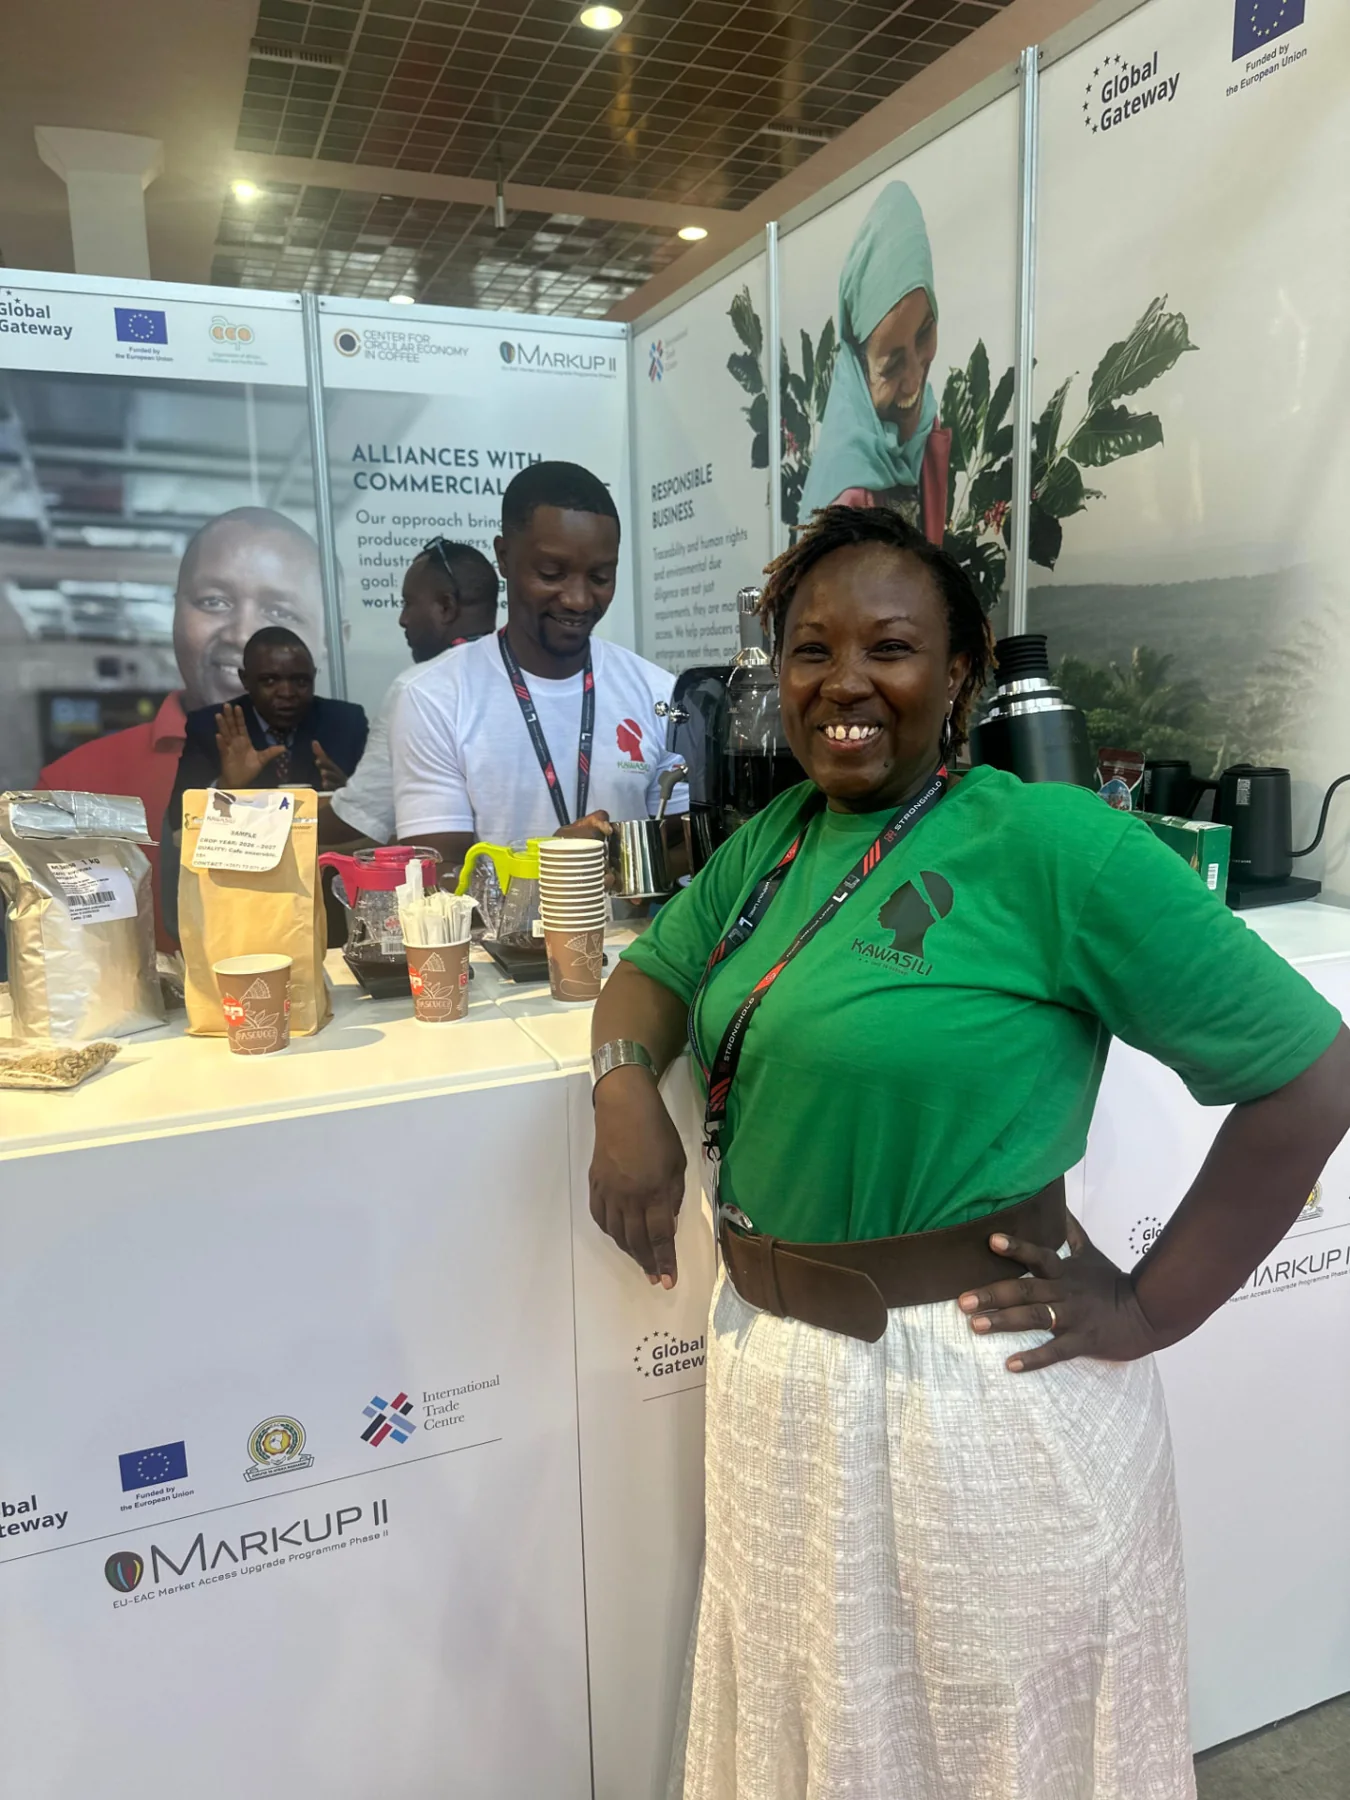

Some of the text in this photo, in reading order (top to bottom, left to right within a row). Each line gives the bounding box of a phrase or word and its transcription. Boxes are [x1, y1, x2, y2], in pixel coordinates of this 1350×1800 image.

[1245, 42, 1290, 72] Funded by
[1101, 51, 1158, 104] Global
[1225, 47, 1308, 97] the European Union
[1100, 73, 1180, 132] Gateway
[0, 302, 51, 319] Global
[0, 319, 73, 341] Gateway
[363, 329, 431, 343] CENTER FOR
[126, 353, 155, 362] European
[129, 346, 152, 354] Funded
[363, 340, 469, 356] CIRCULAR ECONOMY
[364, 350, 420, 363] IN COFFEE
[351, 444, 543, 470] ALLIANCES WITH
[353, 471, 504, 496] COMMERCIAL
[651, 463, 713, 503] RESPONSIBLE
[355, 509, 386, 524] Our
[391, 512, 463, 530] approach
[652, 499, 695, 530] BUSINESS
[687, 536, 699, 553] and
[700, 535, 724, 549] human
[725, 526, 748, 547] rights
[359, 551, 414, 568] industr
[653, 566, 665, 581] and
[708, 554, 722, 570] due
[360, 572, 398, 591] goal:
[680, 587, 689, 597] are
[692, 601, 706, 618] they
[708, 604, 720, 614] are
[721, 602, 737, 613] mar
[699, 620, 733, 638] producers
[278, 796, 290, 810] A
[894, 780, 942, 831] STRONGHOLD
[230, 830, 257, 839] SAMPLE
[197, 845, 227, 853] QUALITY:
[850, 937, 933, 977] KAWASILI
[723, 997, 755, 1062] STRONGHOLD
[1249, 1287, 1271, 1299] Access
[1272, 1283, 1297, 1293] Upgrade
[1298, 1274, 1330, 1286] Programme
[1330, 1269, 1348, 1278] Phase
[652, 1335, 704, 1361] Global
[652, 1355, 706, 1377] Gatew
[422, 1374, 501, 1403] International
[422, 1400, 460, 1417] Trade
[423, 1414, 465, 1431] Centre
[120, 1489, 195, 1512] the European Union
[135, 1485, 176, 1500] Funded by
[0, 1495, 38, 1518] bal
[373, 1498, 388, 1527] II
[0, 1511, 69, 1539] teway
[112, 1529, 389, 1609] EU-EAC Market Access Upgrade Programme Phase II
